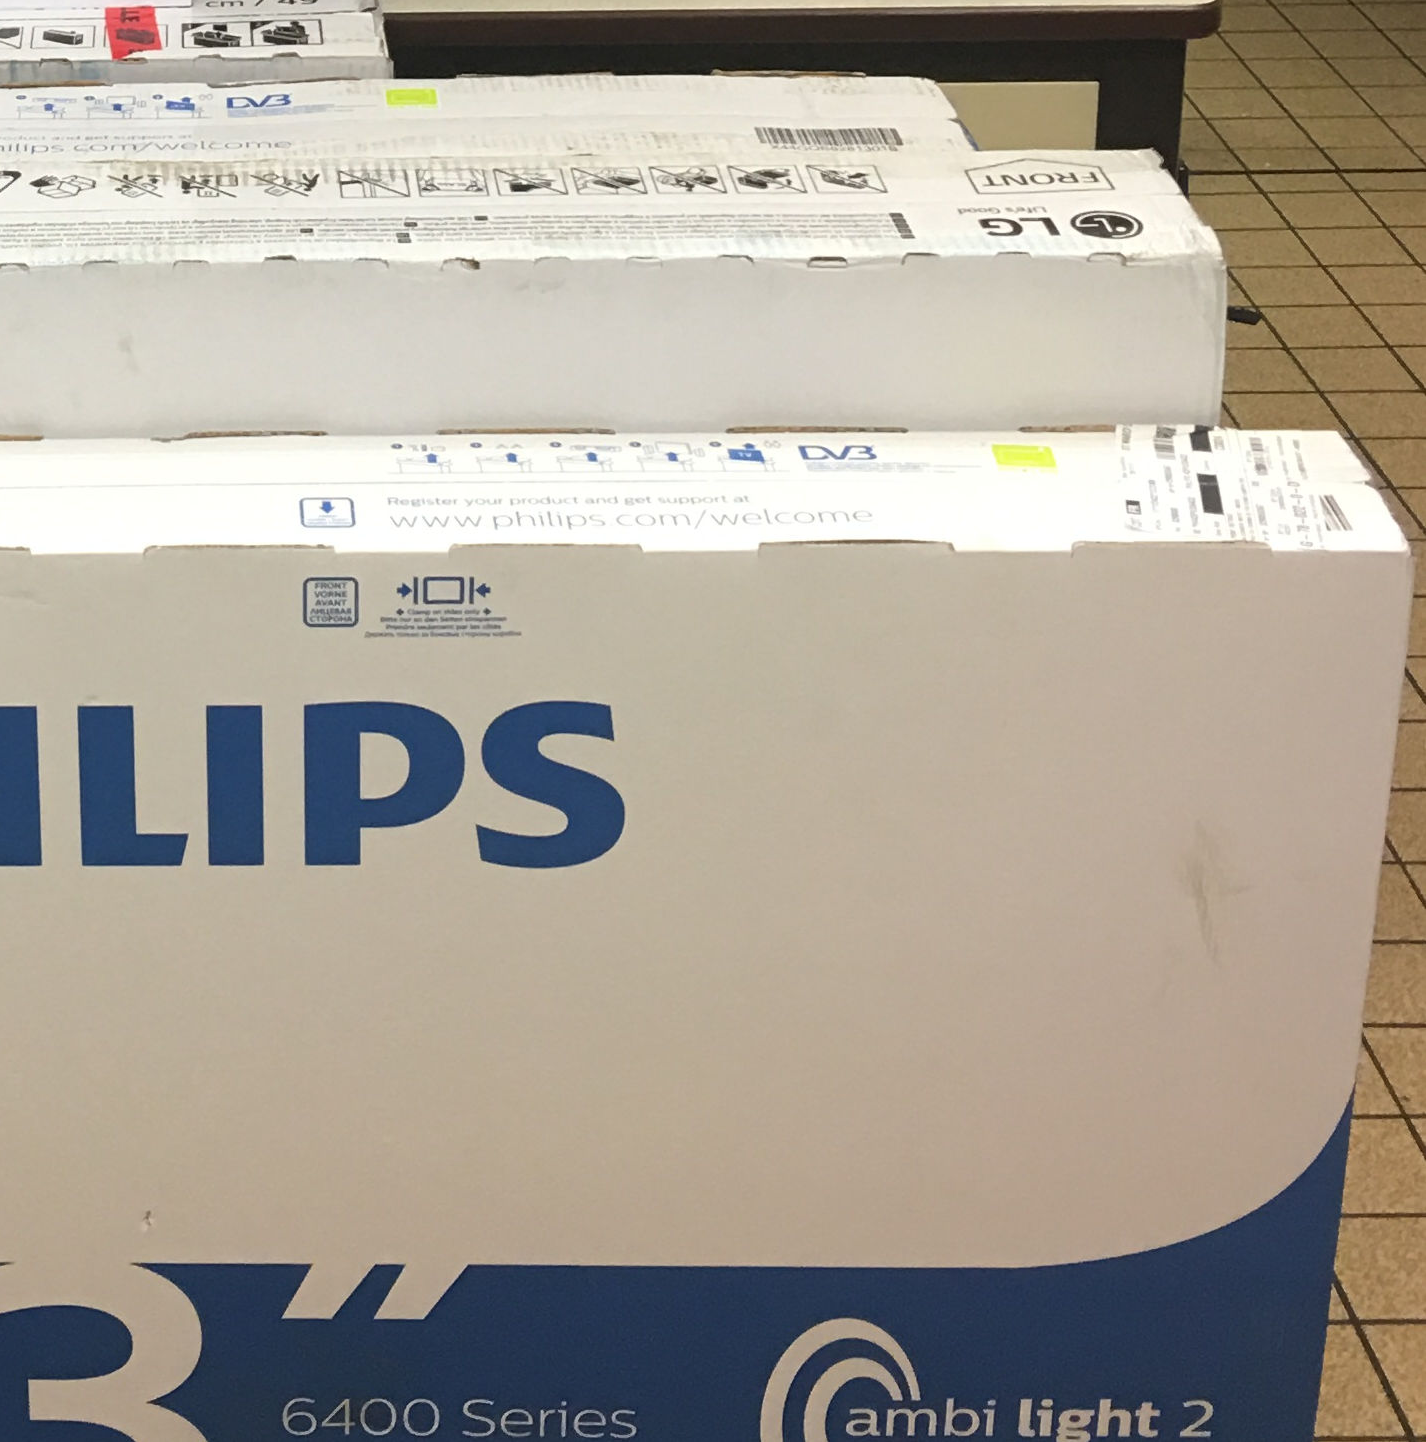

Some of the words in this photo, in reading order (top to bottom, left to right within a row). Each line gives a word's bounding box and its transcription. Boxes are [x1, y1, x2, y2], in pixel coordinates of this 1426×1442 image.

[205, 0, 244, 8] cm
[226, 94, 292, 108] DVB
[982, 171, 1101, 188] FRONT
[980, 217, 1061, 237] LG
[798, 445, 877, 461] DVB
[387, 496, 458, 507] Register
[464, 497, 503, 507] your
[510, 496, 578, 507] product
[585, 495, 618, 505] and
[624, 496, 652, 507] get
[658, 494, 727, 505] support
[733, 494, 750, 504] at
[314, 582, 347, 590] FRONT
[315, 599, 347, 607] AVANT
[281, 1397, 441, 1438] 6400
[462, 1397, 638, 1438] Series
[845, 1398, 994, 1438] ambi
[1016, 1398, 1160, 1442] light
[1180, 1398, 1216, 1438] 2
